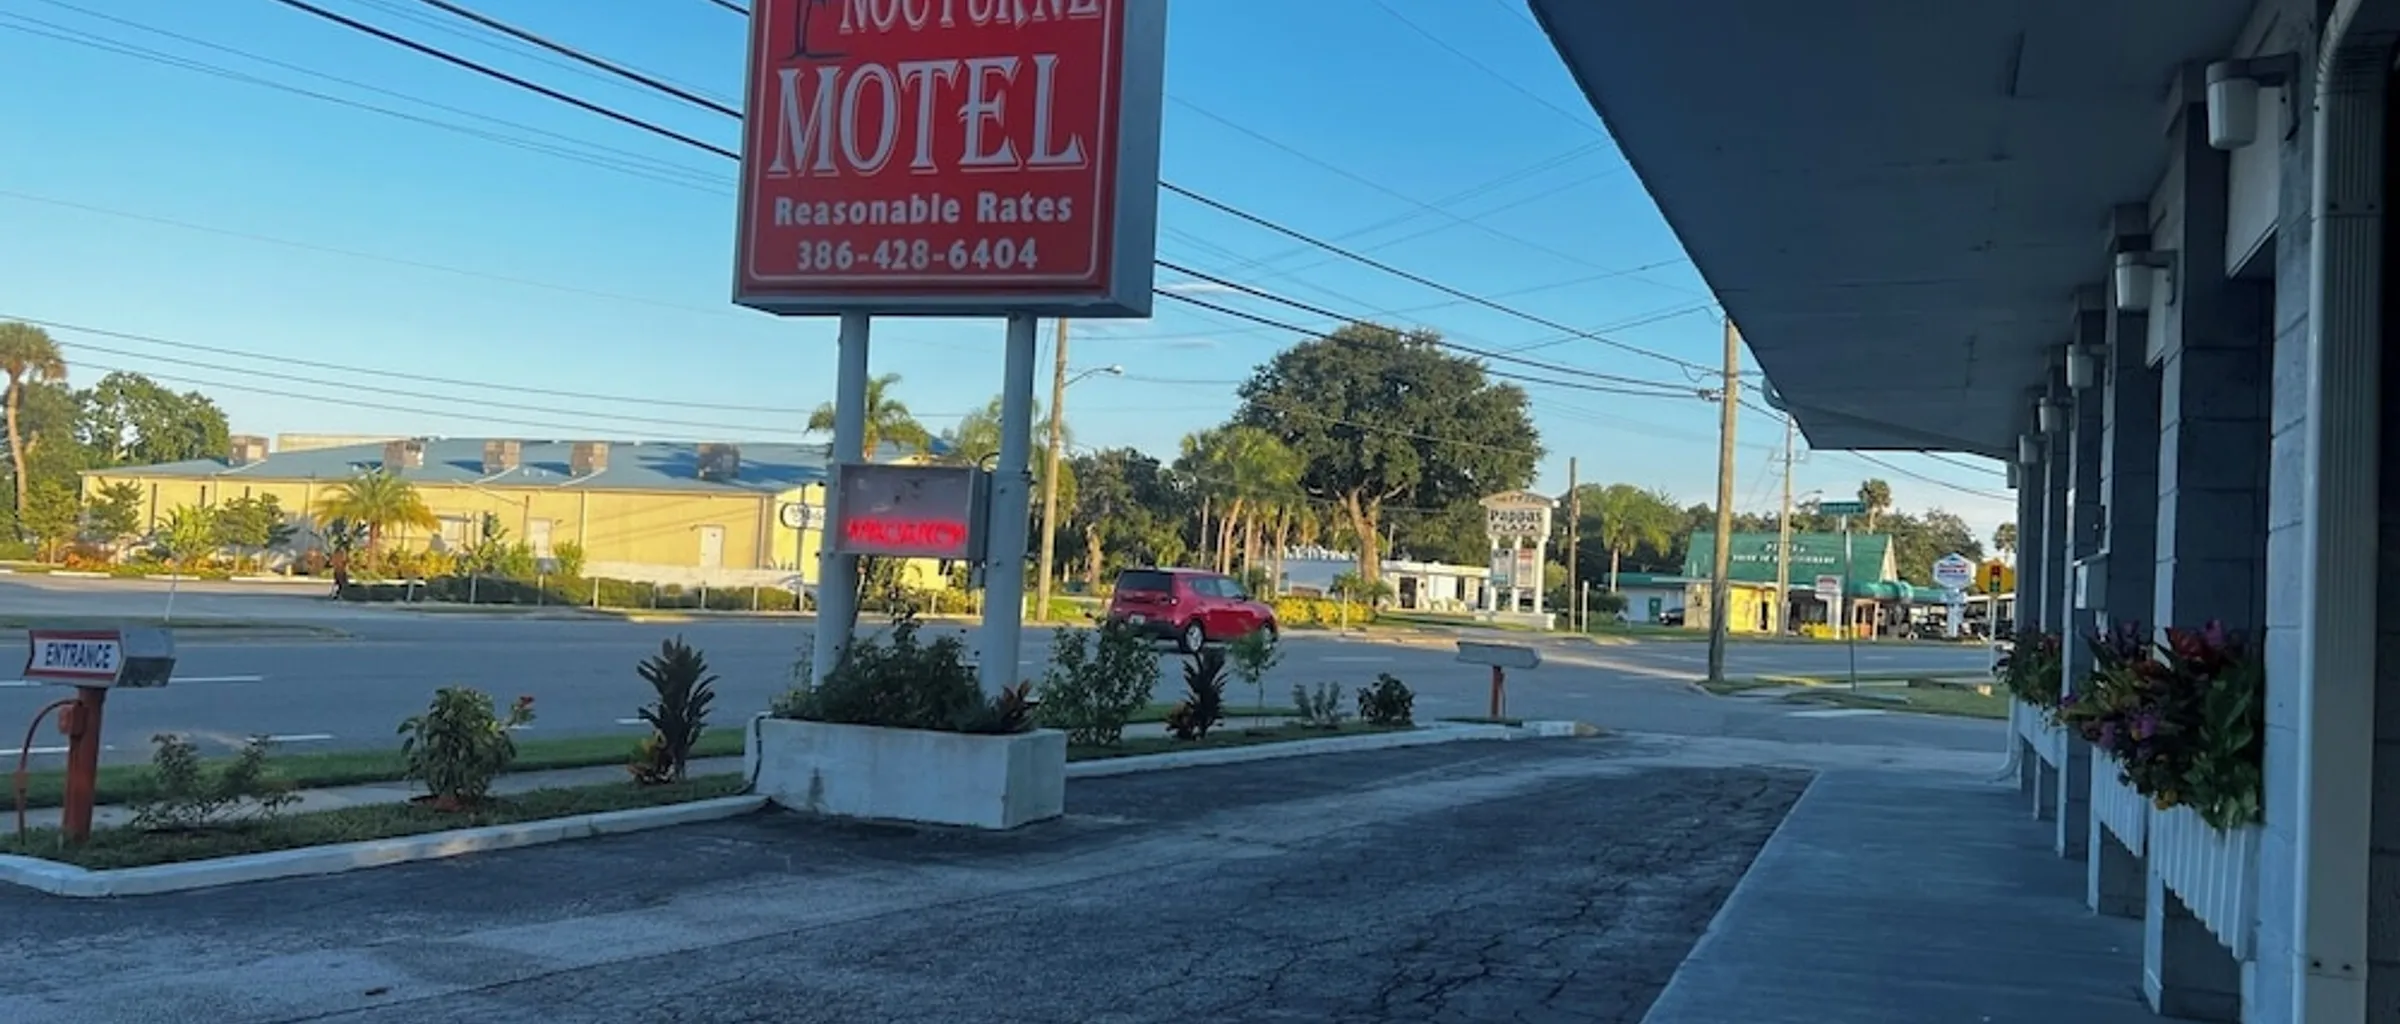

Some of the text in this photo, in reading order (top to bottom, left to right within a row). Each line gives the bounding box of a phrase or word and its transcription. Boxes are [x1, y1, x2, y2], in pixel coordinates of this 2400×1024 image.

[767, 53, 1088, 178] MOTEL
[775, 190, 1072, 225] Reasonable Rates
[798, 239, 1037, 270] 386-428-6404
[45, 642, 112, 668] ENTRANCE
